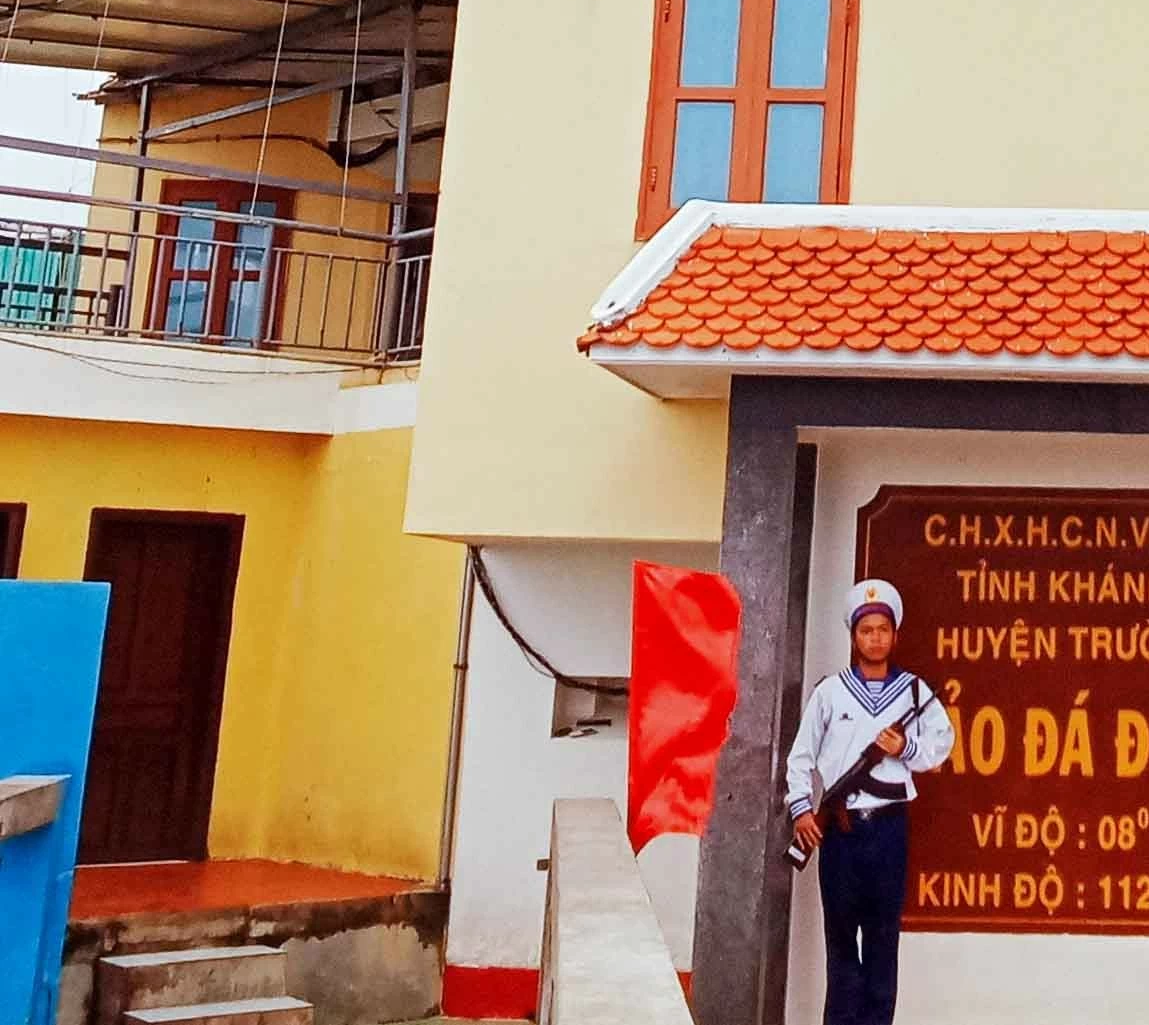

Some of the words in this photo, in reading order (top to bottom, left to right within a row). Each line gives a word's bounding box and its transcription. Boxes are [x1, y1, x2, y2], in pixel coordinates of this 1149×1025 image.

[957, 559, 1035, 601] TỈNH
[938, 619, 1056, 666] HUYỆN
[935, 680, 1005, 775] ẢO
[1023, 690, 1093, 776] ĐÁ
[973, 806, 1007, 847] VĨ
[1015, 806, 1065, 855] ĐỘ
[919, 873, 1000, 907] KINH
[1014, 864, 1063, 915] ĐỘ
